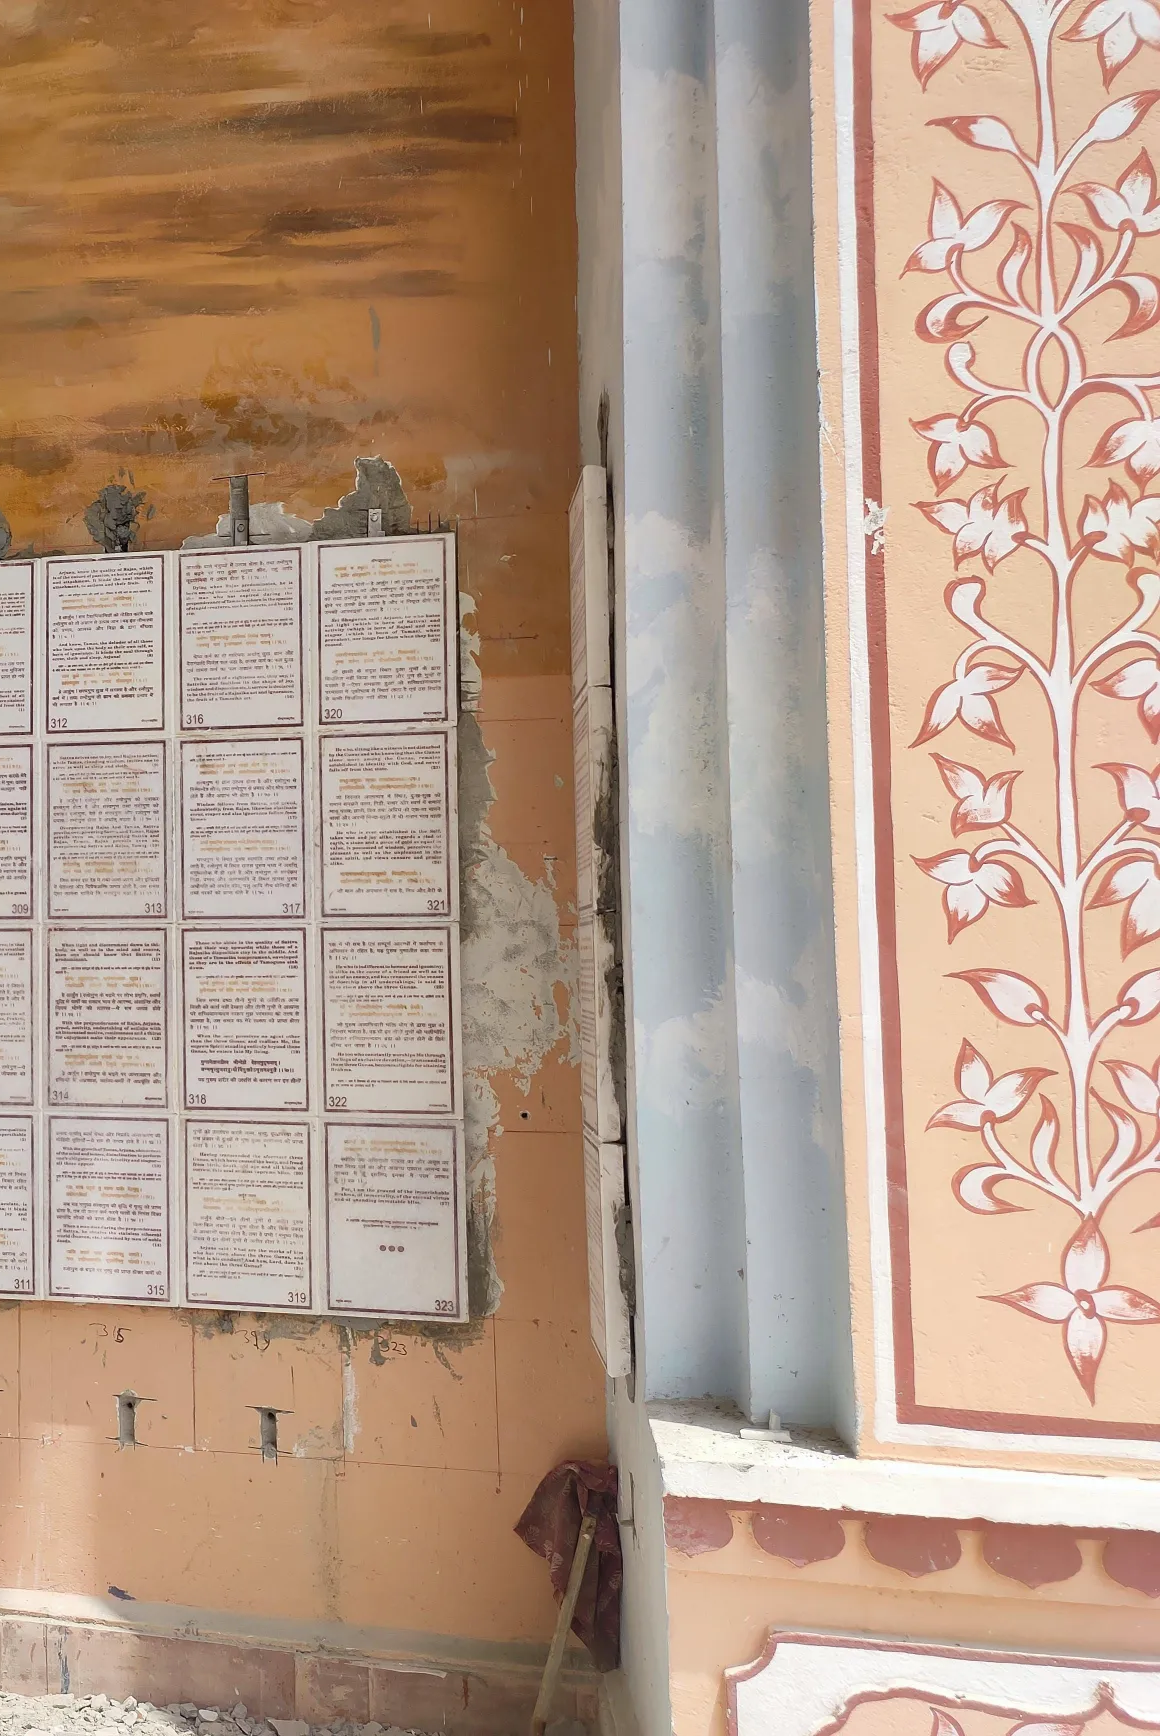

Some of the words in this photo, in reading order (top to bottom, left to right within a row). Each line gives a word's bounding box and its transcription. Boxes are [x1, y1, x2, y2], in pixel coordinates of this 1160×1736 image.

[324, 709, 342, 718] 320
[51, 718, 67, 728] 312
[186, 714, 203, 724] 316
[12, 904, 28, 914] 309
[145, 903, 162, 913] 313
[282, 903, 300, 913] 317
[427, 900, 445, 910] 321
[52, 1091, 69, 1100] 314
[189, 1094, 206, 1104] 318
[329, 1097, 347, 1107] 322
[14, 1279, 30, 1289] 311
[147, 1285, 164, 1295] 315
[288, 1292, 306, 1303] 319
[435, 1300, 454, 1311] 323
